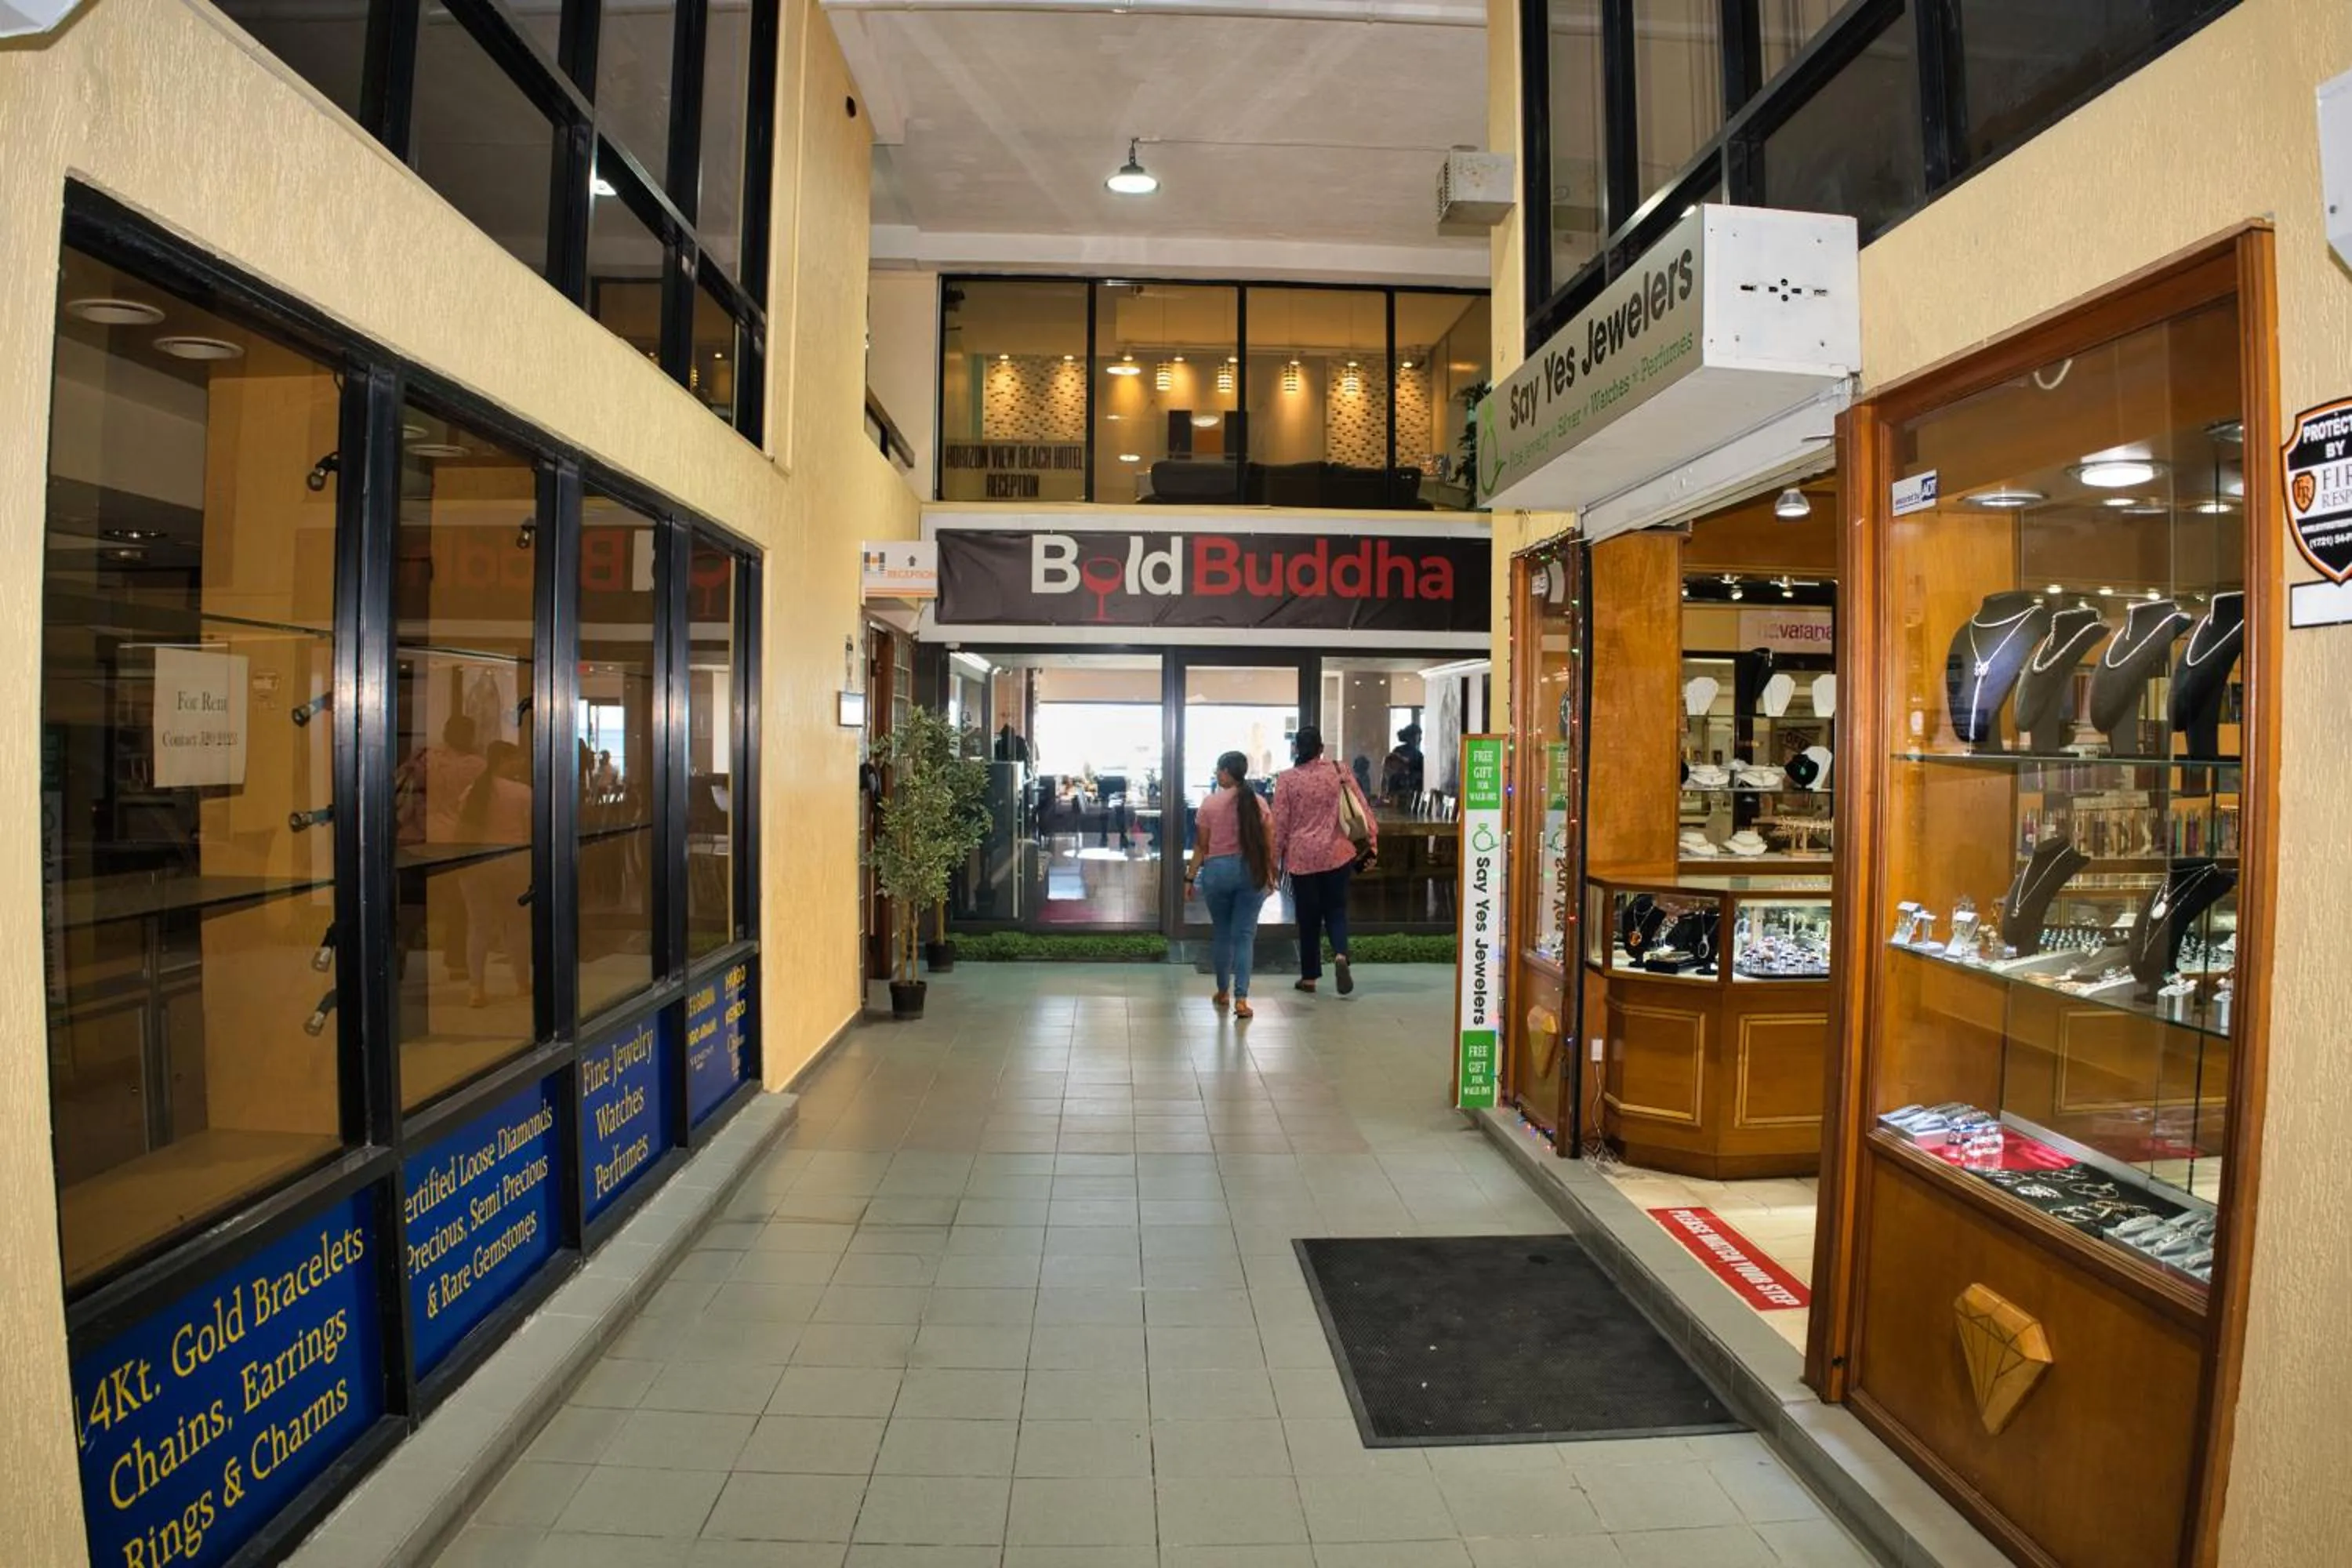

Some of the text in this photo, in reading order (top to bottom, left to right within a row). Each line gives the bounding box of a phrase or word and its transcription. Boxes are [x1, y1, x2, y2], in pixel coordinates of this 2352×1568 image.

[1510, 249, 1692, 430] Say Yes Jewelers
[1641, 332, 1693, 382] Perfumes
[946, 445, 1083, 470] HORIZON VIEW BEACH HOTEL
[2325, 439, 2346, 459] BY
[986, 474, 1039, 497] RECEPTION
[1193, 536, 1454, 600] Buddha
[177, 691, 198, 710] For
[1473, 750, 1493, 763] FREE
[1473, 766, 1493, 779] GIFT
[1473, 857, 1490, 1025] Say Yes Jewelers
[582, 1059, 610, 1097] Fine
[612, 1025, 653, 1087] Jewelry
[1468, 1045, 1488, 1058] FREE
[1468, 1061, 1486, 1073] GIFT
[596, 1085, 644, 1142] Watches
[405, 1098, 554, 1224] ertified Loose Diamonds
[470, 1184, 501, 1232] Semi
[503, 1155, 549, 1205] Precious
[594, 1134, 648, 1200] Perfumes
[427, 1210, 537, 1319] & Rare Gemstones
[1697, 1233, 1748, 1262] WATCH
[1729, 1261, 1773, 1285] YOUR
[1755, 1283, 1802, 1305] STEP
[171, 1286, 246, 1378] Gold
[252, 1227, 365, 1327] Bracelets
[110, 1308, 347, 1510] Chains, Earrings
[123, 1378, 349, 1568] Rings & Charms
